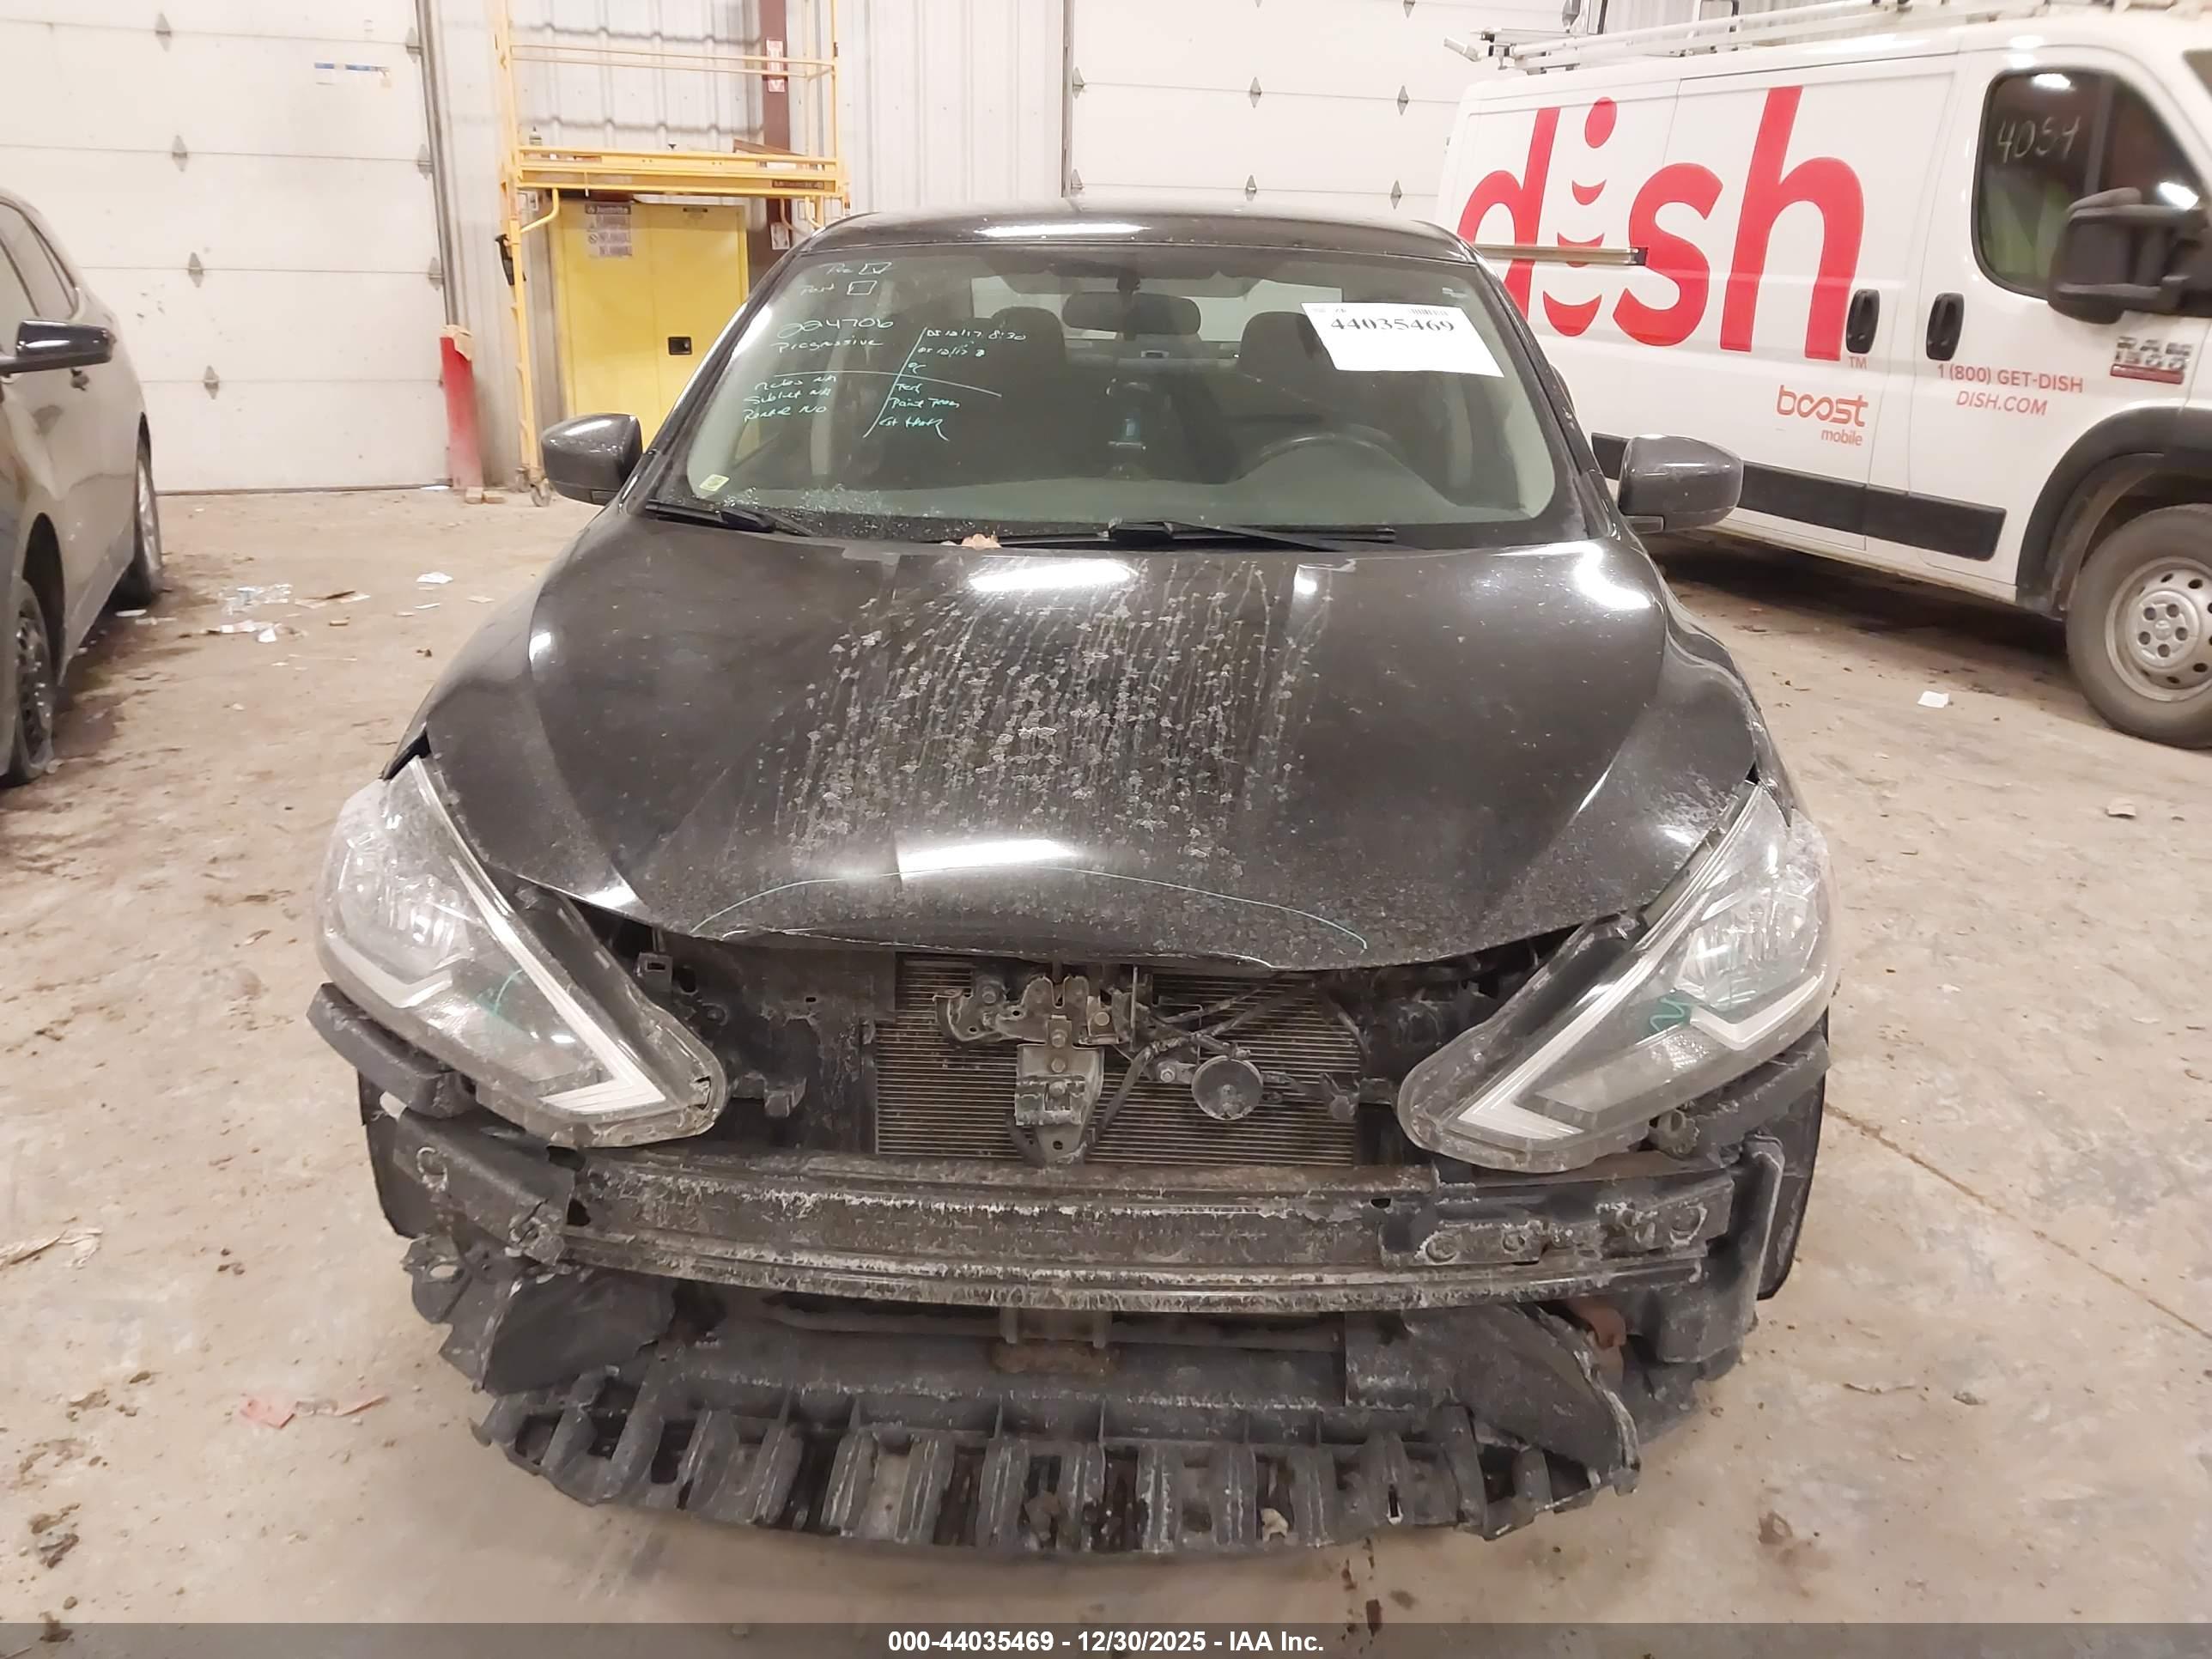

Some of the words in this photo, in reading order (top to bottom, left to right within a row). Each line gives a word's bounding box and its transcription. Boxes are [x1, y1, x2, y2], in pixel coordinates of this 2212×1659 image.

[1457, 85, 1864, 361] dish
[1331, 318, 1455, 332] 44035469
[1848, 356, 1867, 369] TM
[1937, 363, 1945, 379] 1
[1948, 365, 1992, 386] (800)
[1996, 368, 2084, 393] GET-DISH
[1777, 384, 1869, 428] boost
[1956, 390, 2048, 416] DISH.COM
[1820, 428, 1863, 447] mobile
